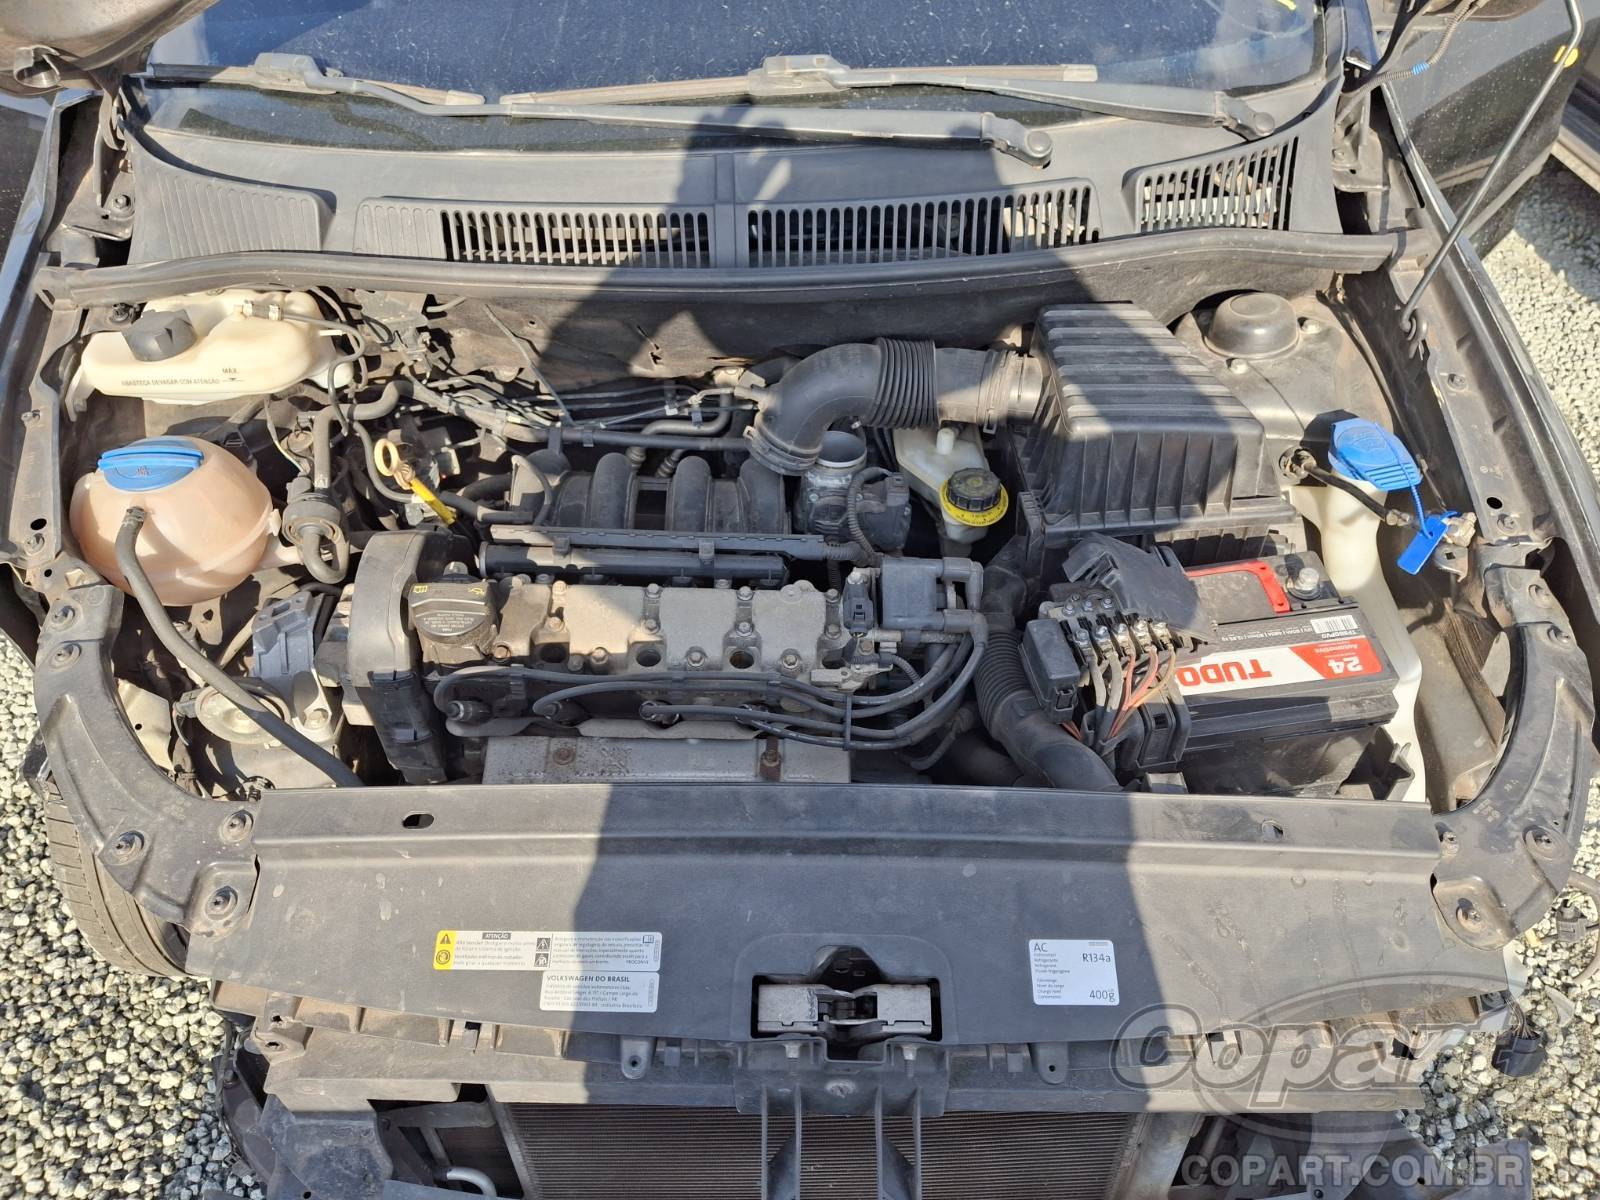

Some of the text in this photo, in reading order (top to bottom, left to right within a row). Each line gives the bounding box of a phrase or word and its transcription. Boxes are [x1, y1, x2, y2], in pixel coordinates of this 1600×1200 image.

[1327, 656, 1364, 674] 24
[1034, 942, 1048, 952] AC
[1082, 952, 1111, 963] R134a
[1089, 990, 1116, 1002] 400g
